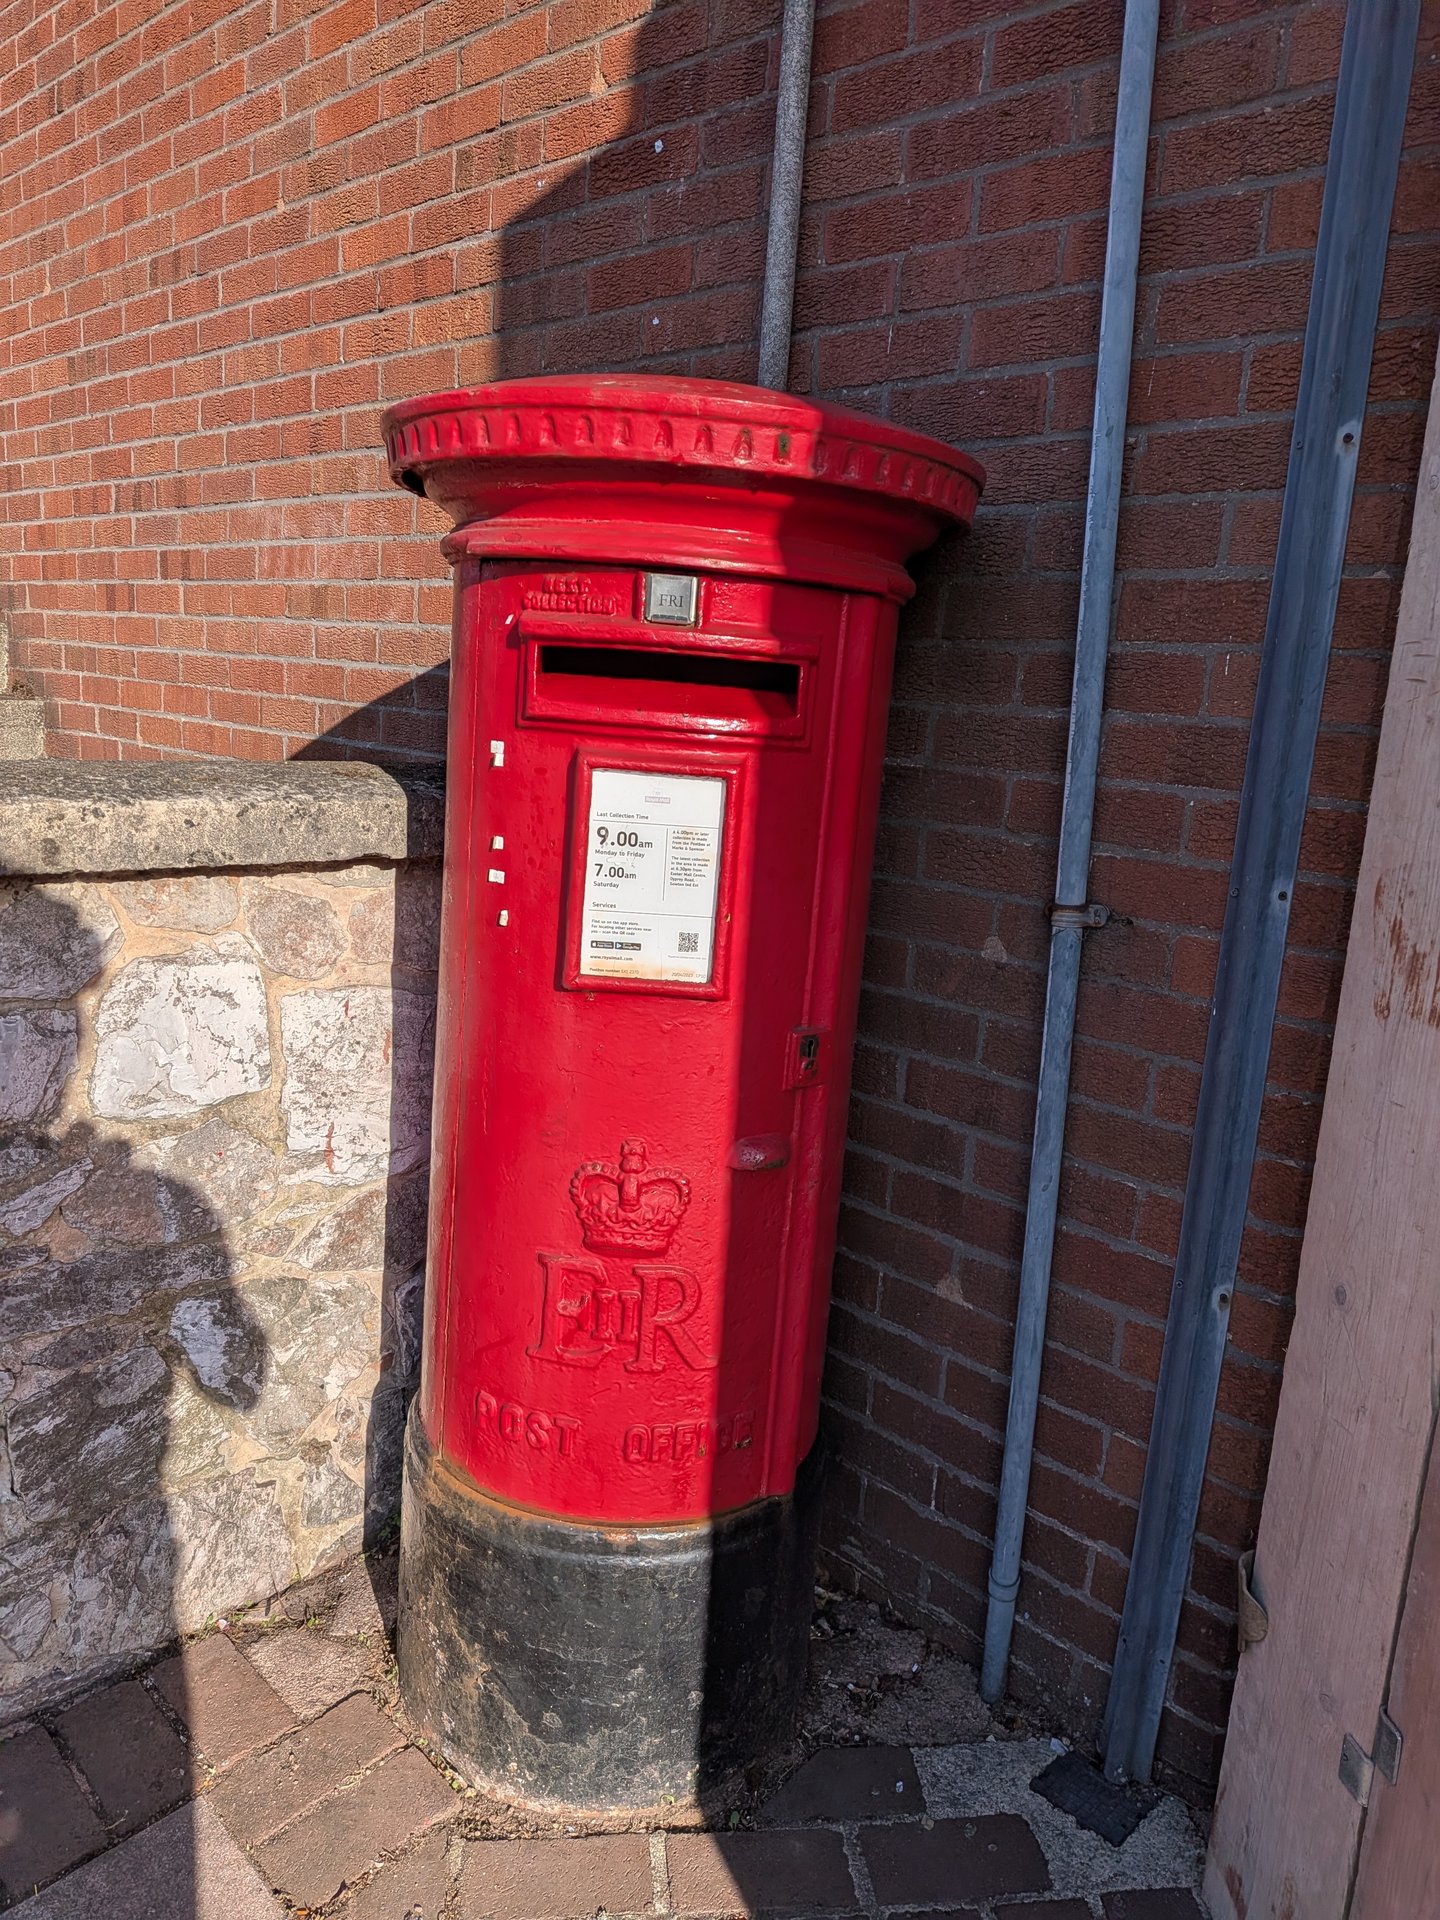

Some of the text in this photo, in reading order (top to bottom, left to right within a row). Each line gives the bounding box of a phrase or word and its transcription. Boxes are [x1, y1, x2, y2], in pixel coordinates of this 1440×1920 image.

[658, 593, 684, 607] FRI
[609, 811, 635, 819] Collection
[597, 826, 653, 848] 9.00am
[594, 849, 617, 857] Monday
[626, 850, 645, 859] Friday
[594, 863, 637, 879] 7.00am
[593, 880, 620, 889] Saturday
[592, 901, 617, 909] Services
[475, 1388, 583, 1458] POST
